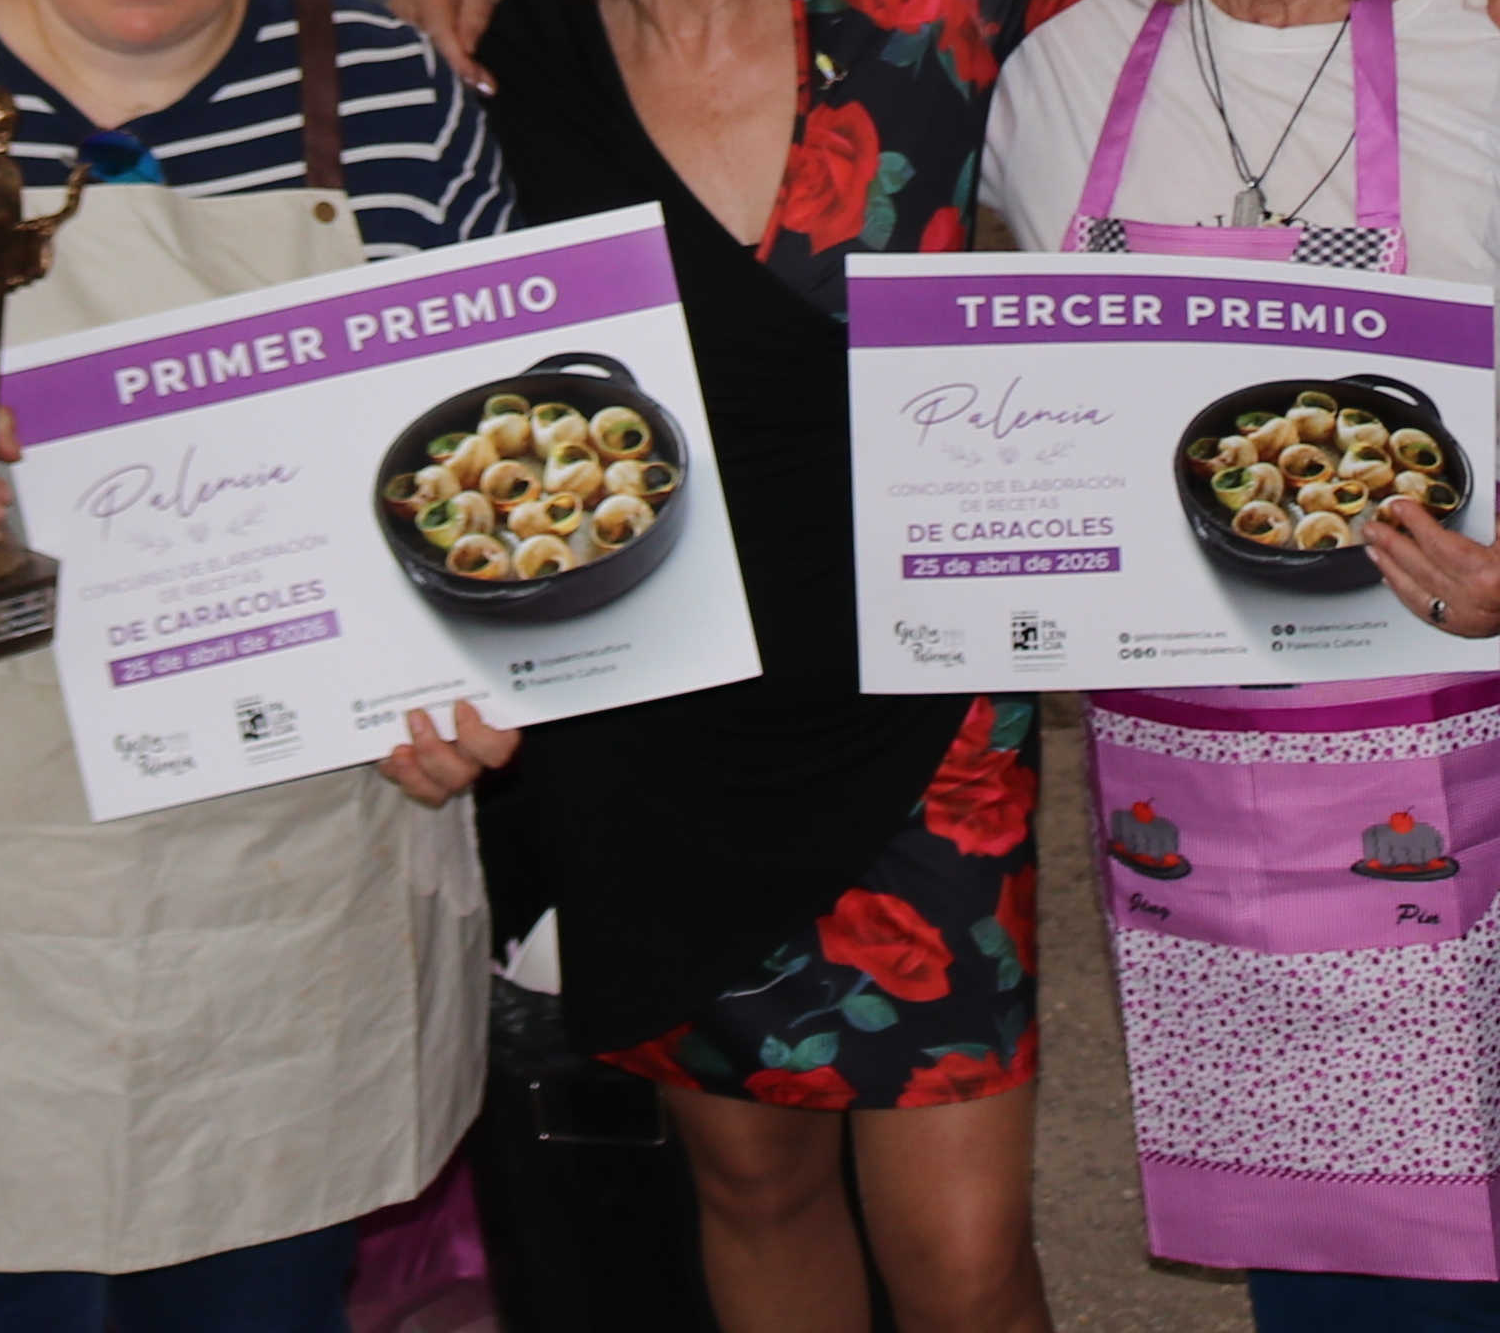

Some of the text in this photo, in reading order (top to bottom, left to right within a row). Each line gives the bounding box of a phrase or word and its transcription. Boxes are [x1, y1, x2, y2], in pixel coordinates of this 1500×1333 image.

[956, 294, 1388, 339] TERCER PREMIO
[113, 275, 558, 406] PRIMER PREMIO
[899, 376, 1115, 445] Palencia
[74, 444, 301, 540] Palencia
[888, 481, 981, 497] CONCURSO
[984, 481, 1003, 494] DE
[961, 496, 1060, 512] DE RECETAS
[907, 517, 1114, 542] DE CARACOLES
[912, 552, 1110, 575] 25 de abril de 2026
[107, 580, 327, 646] DE CARACOLES
[120, 659, 150, 682] 25
[151, 653, 184, 674] de
[185, 640, 235, 667] abril
[237, 634, 268, 654] de
[1396, 904, 1440, 925] Pin
